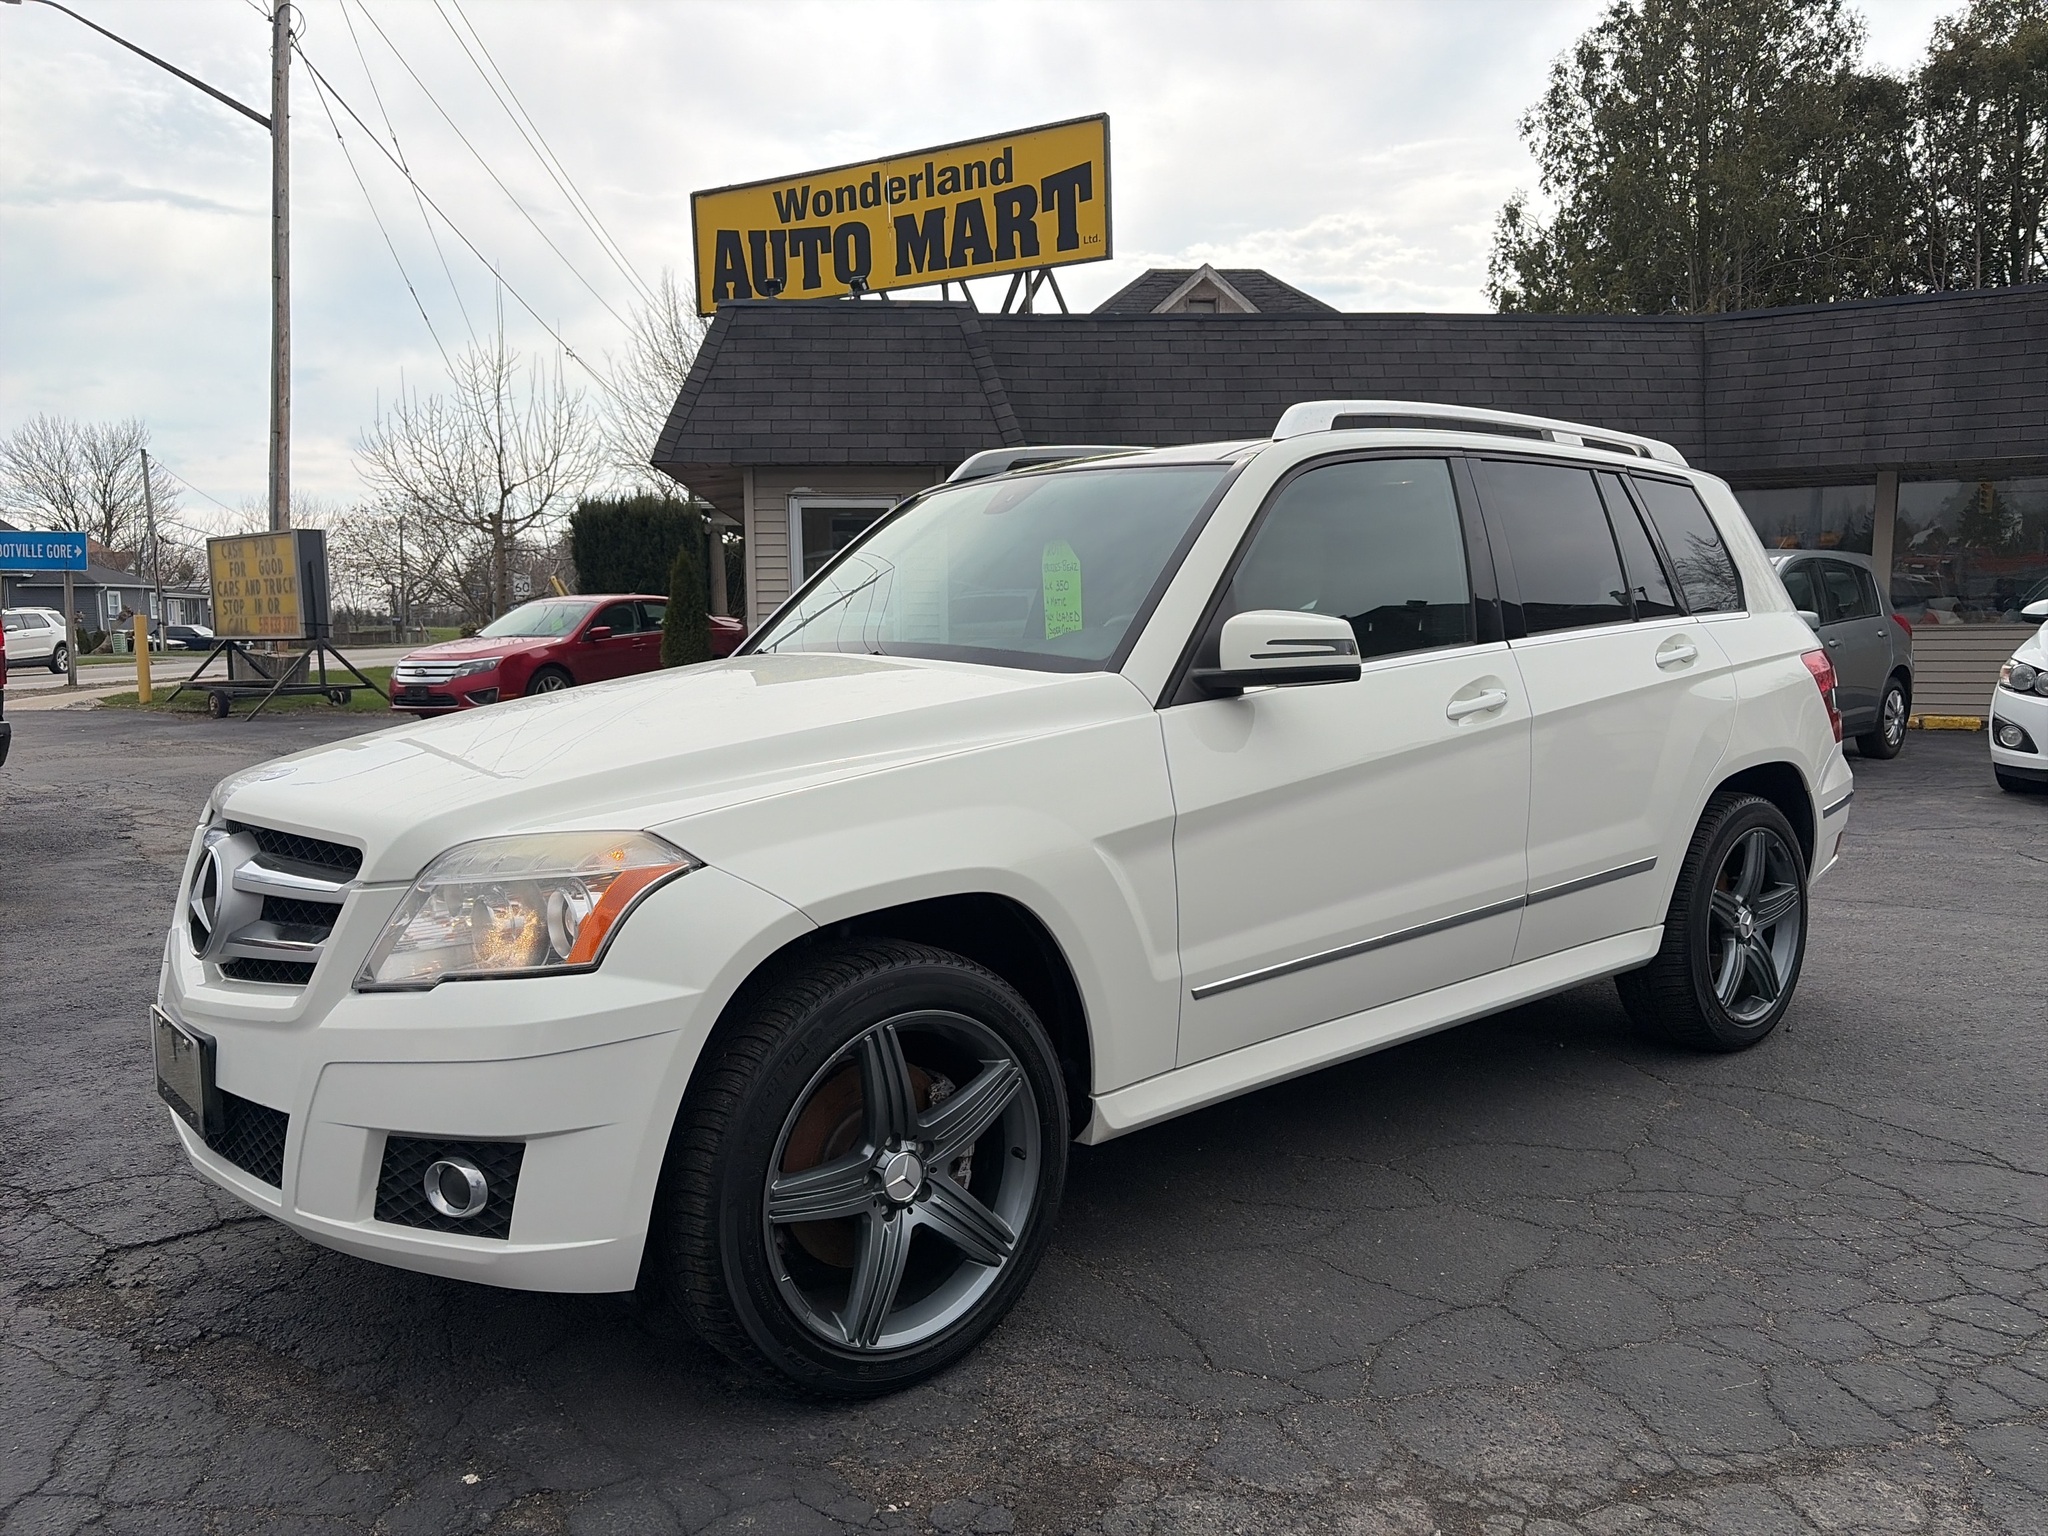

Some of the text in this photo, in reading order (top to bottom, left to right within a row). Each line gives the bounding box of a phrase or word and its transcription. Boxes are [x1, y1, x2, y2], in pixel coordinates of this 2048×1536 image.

[772, 146, 1014, 223] Wonderland
[712, 160, 1093, 304] AUTO MART
[1083, 233, 1102, 246] Ltd.
[46, 544, 73, 559] GORE
[229, 558, 284, 577] FOR GOOD
[217, 580, 240, 598] CARS
[244, 579, 261, 596] AND
[515, 582, 530, 592] 60
[1055, 579, 1070, 592] 350
[222, 598, 245, 615] STOP
[267, 597, 281, 614] OR
[228, 617, 249, 633] CALL
